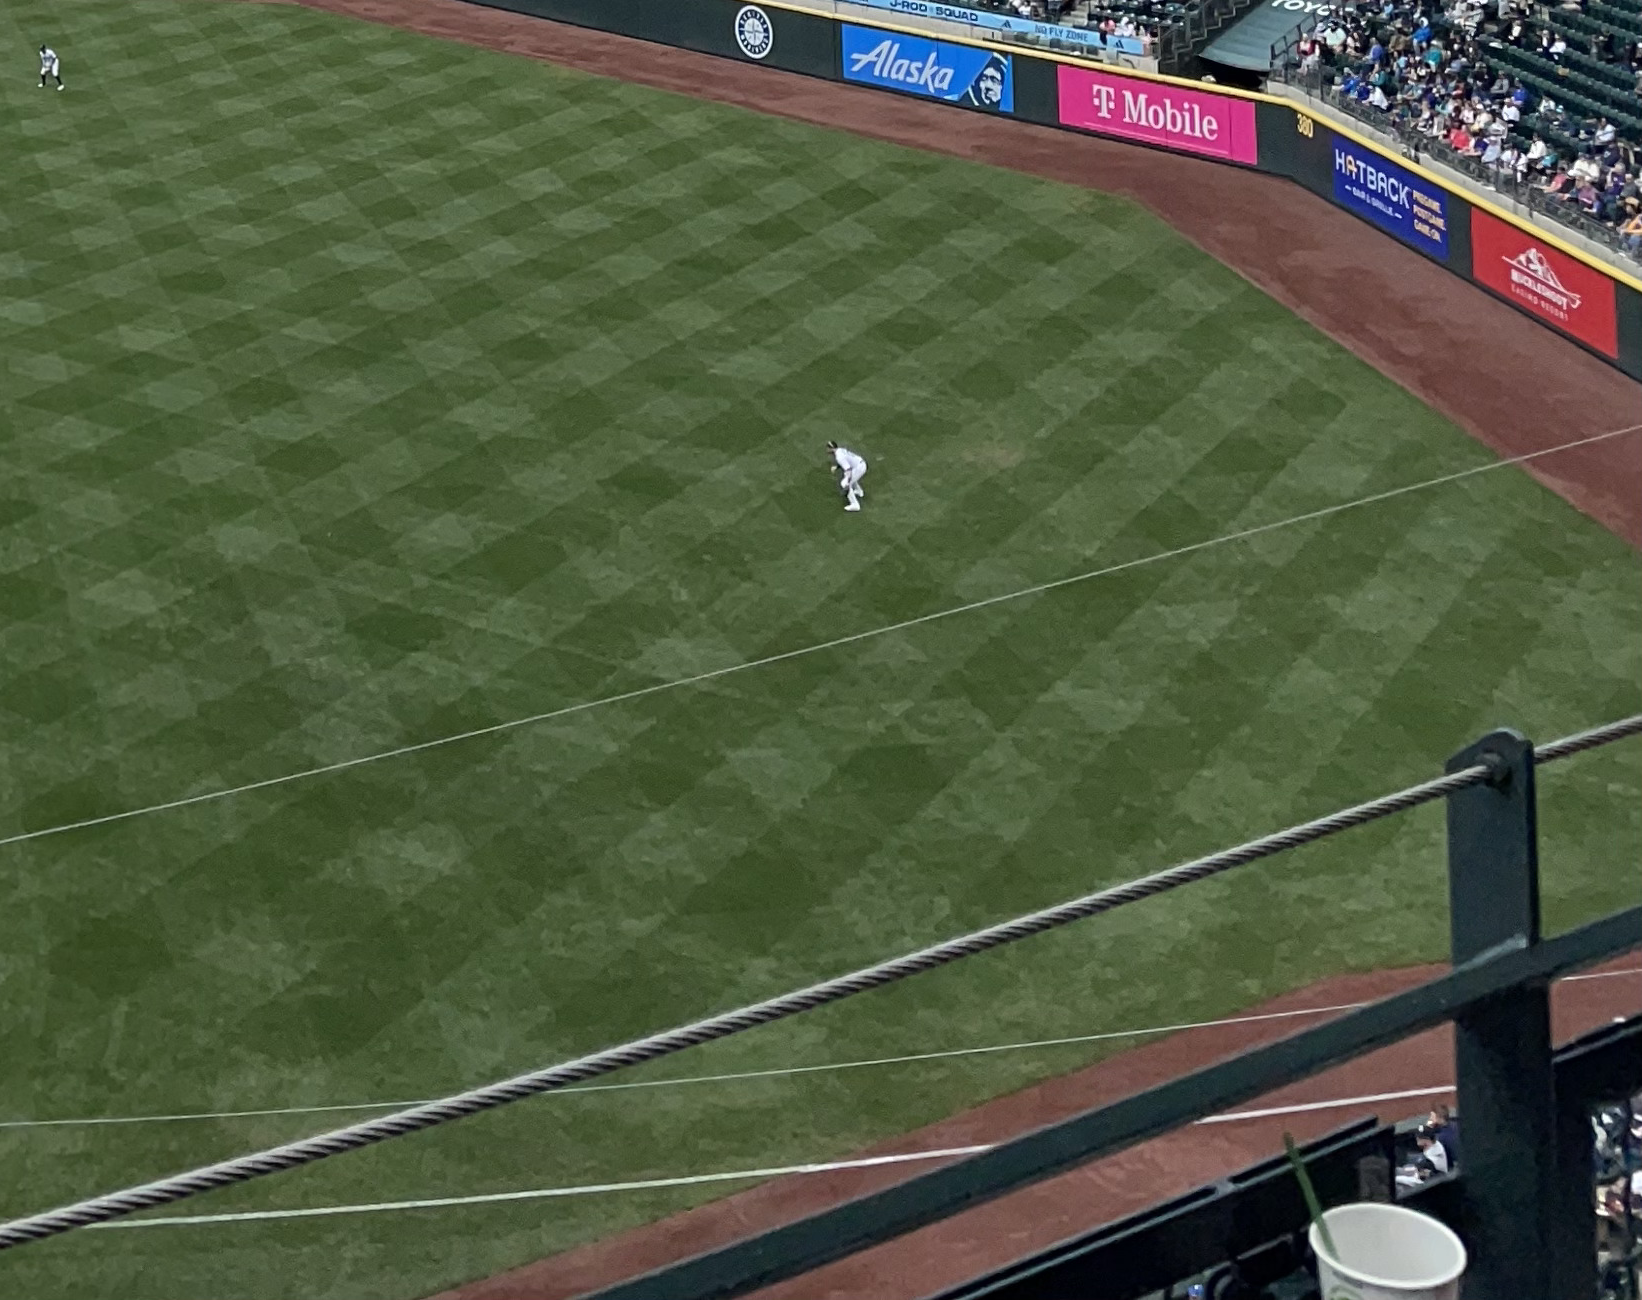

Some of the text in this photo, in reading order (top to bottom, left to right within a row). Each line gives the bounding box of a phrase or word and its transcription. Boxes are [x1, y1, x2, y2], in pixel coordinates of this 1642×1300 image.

[889, 0, 978, 22] J-ROD SQUAD
[1035, 24, 1088, 42] NO FLY ZONE
[851, 40, 954, 93] Alaska
[1092, 85, 1218, 141] T Mobile
[1296, 113, 1314, 138] 380
[1335, 148, 1410, 209] HATBACK
